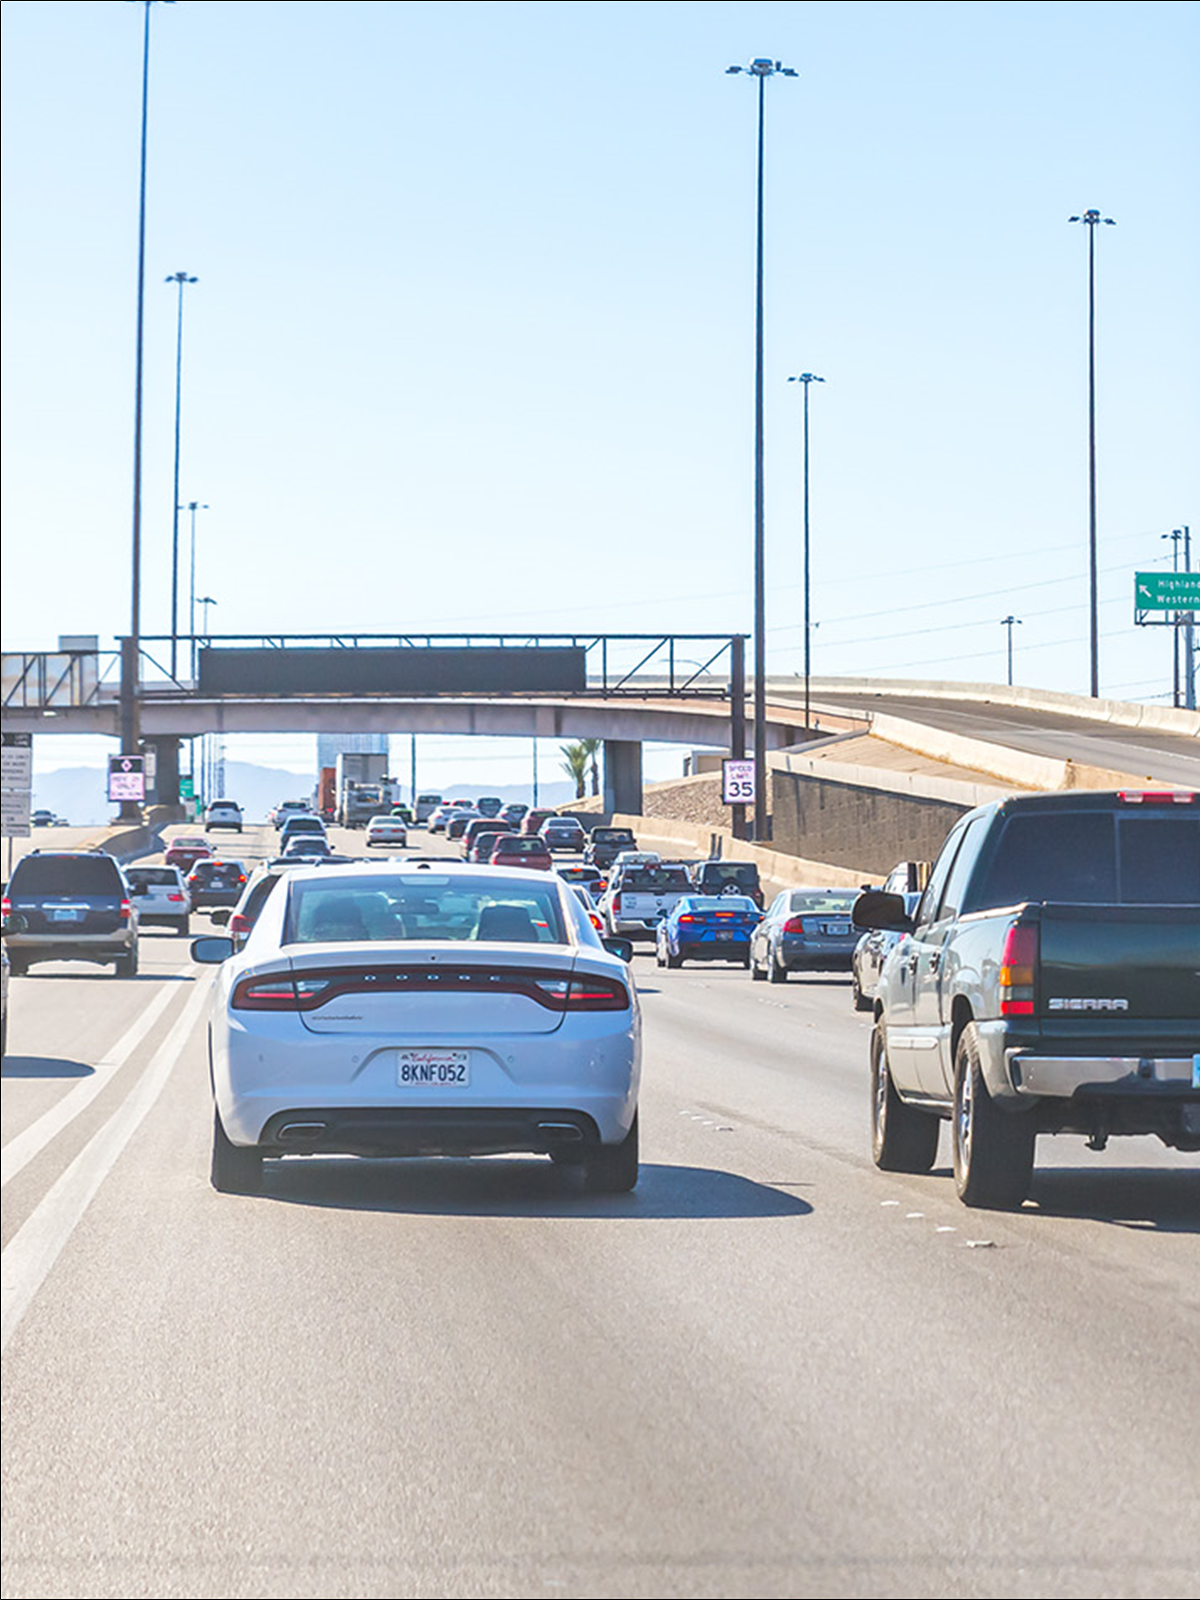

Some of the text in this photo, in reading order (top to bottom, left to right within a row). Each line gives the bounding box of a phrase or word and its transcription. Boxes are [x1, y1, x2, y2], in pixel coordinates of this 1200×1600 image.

[1156, 595, 1200, 604] Western
[728, 781, 754, 797] 35
[1048, 998, 1129, 1011] SIERRA
[401, 1064, 466, 1082] 8KNF052
